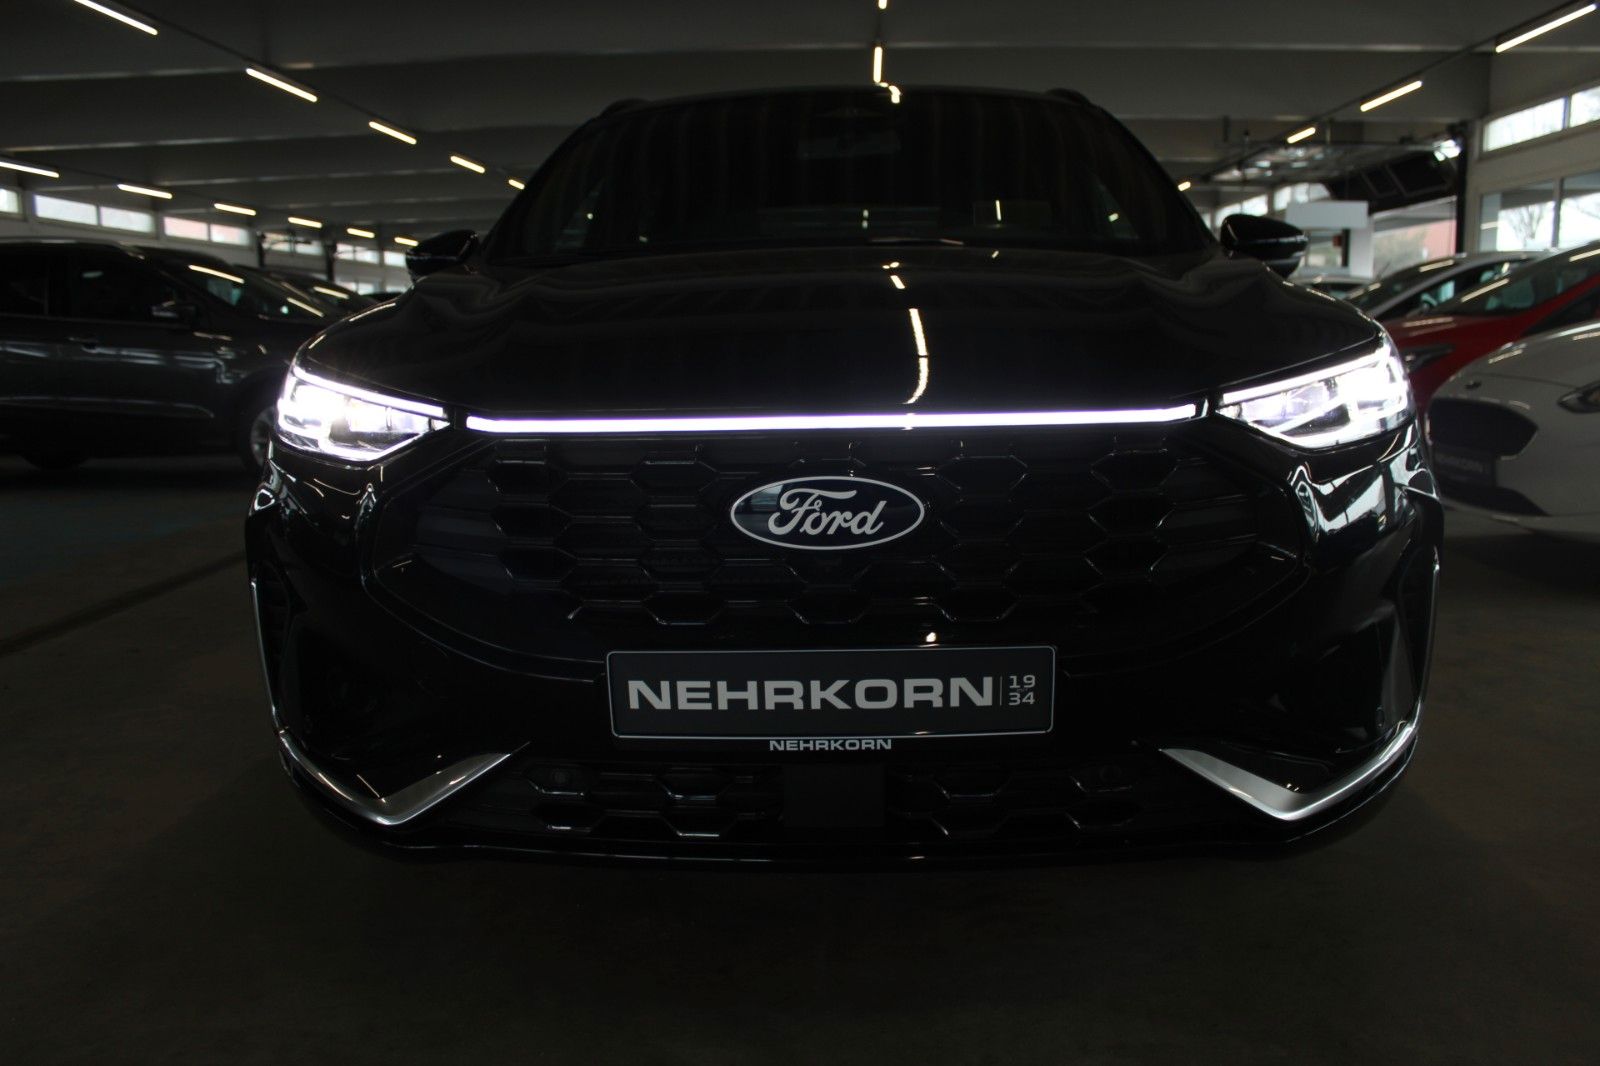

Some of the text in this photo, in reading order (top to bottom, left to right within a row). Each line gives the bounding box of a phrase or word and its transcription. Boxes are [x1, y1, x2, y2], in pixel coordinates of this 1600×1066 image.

[767, 487, 887, 536] Ford
[1009, 674, 1036, 689] 19
[628, 676, 993, 710] NEHRKORN
[1008, 691, 1035, 706] 34
[769, 738, 892, 752] NEHRKORN
